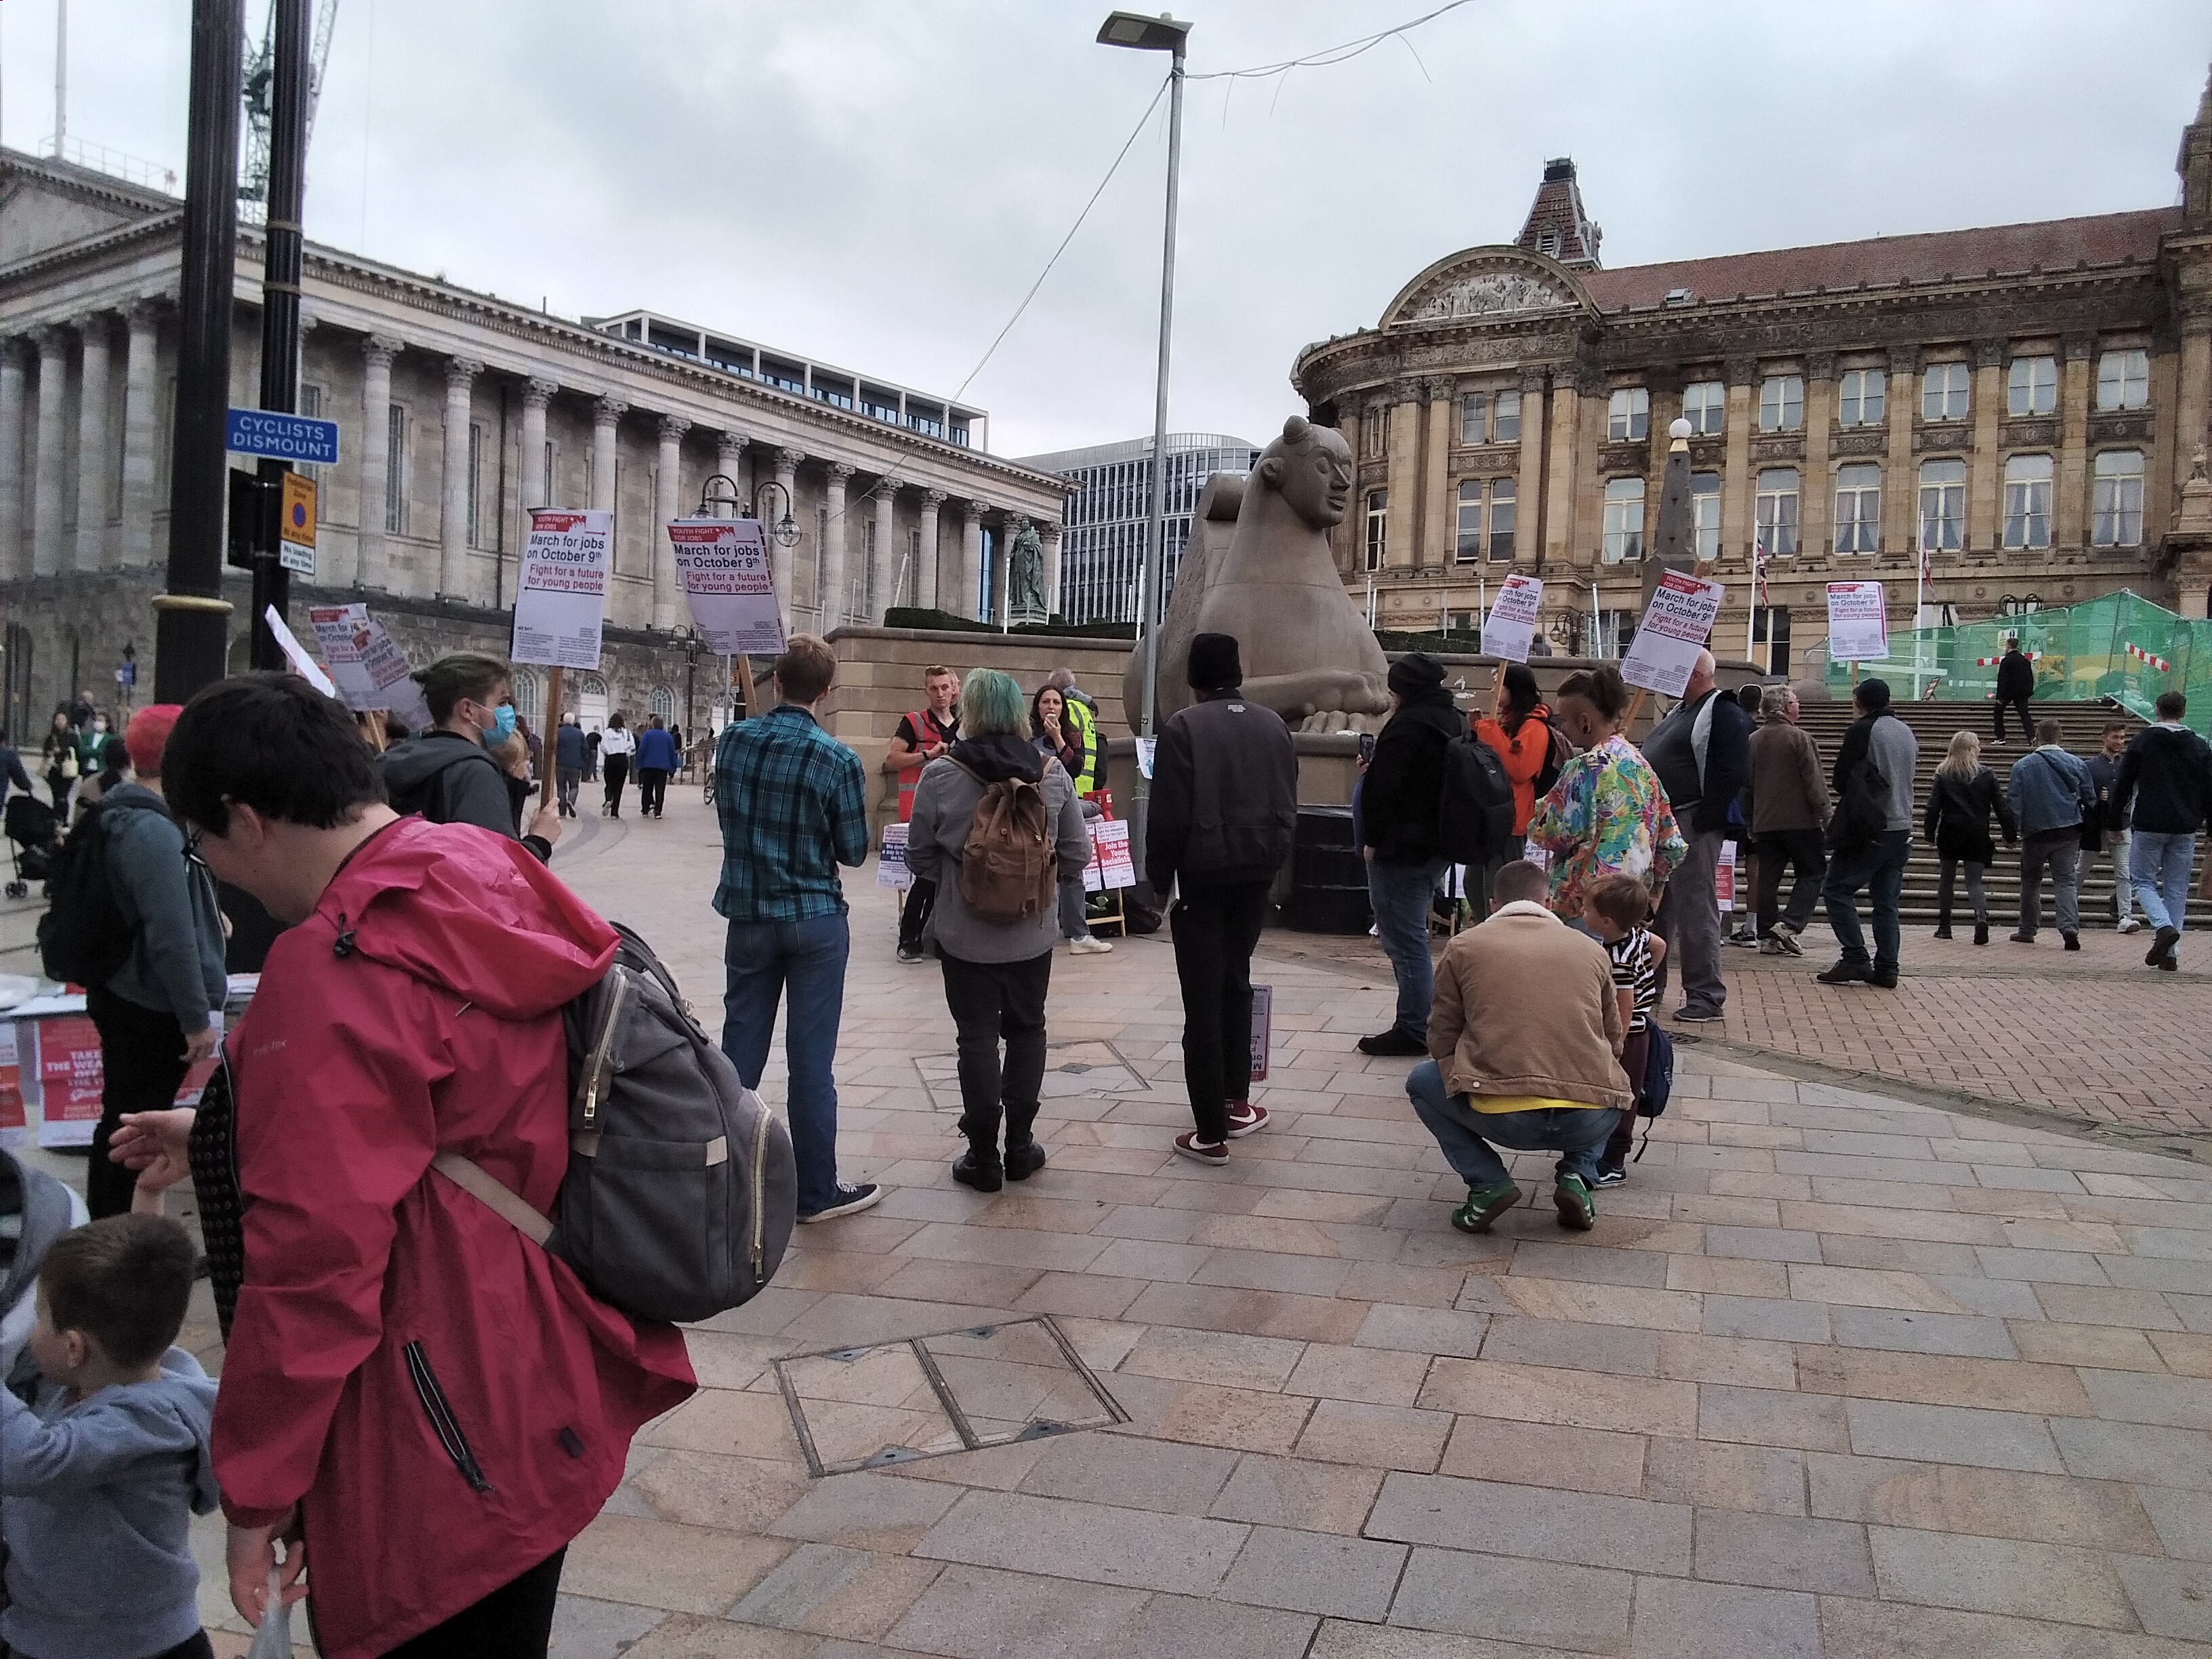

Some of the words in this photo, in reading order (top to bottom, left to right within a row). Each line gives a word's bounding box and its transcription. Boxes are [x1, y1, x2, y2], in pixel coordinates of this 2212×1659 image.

[240, 416, 325, 441] CYCLISTS
[233, 432, 332, 457] DISMOUNT
[530, 534, 559, 546] March
[563, 535, 578, 547] for
[579, 537, 605, 550] jobs
[527, 550, 537, 558] on
[541, 548, 585, 562] October
[588, 551, 602, 562] 9th
[674, 544, 710, 556] March
[714, 545, 731, 555] for
[734, 545, 760, 558] jobs
[678, 558, 690, 567] on
[693, 557, 742, 568] October
[746, 557, 760, 568] 9th
[530, 564, 552, 575] Fight
[555, 566, 567, 576] for
[569, 569, 575, 577] a
[577, 567, 604, 579] future
[686, 571, 711, 581] Fight
[713, 572, 726, 581] for
[737, 572, 766, 581] future
[528, 575, 540, 585] for
[543, 579, 570, 589] young
[573, 581, 603, 591] people
[687, 581, 699, 590] for
[703, 584, 732, 592] young
[735, 583, 769, 592] people
[1502, 596, 1527, 606] October
[1524, 593, 1537, 601] jobs
[1656, 588, 1685, 604] March
[1686, 597, 1699, 607] for
[1698, 600, 1715, 612] jobs
[1652, 601, 1664, 609] on
[1666, 603, 1701, 619] October
[1701, 613, 1712, 621] 9th
[1647, 620, 1658, 629] for
[1658, 625, 1681, 637] young
[1681, 631, 1704, 641] people
[1652, 613, 1672, 624] Fight
[1673, 616, 1683, 626] for
[1689, 622, 1708, 634] future
[1105, 842, 1117, 851] Join
[1111, 848, 1129, 857] Young
[1101, 856, 1131, 866] Socialists
